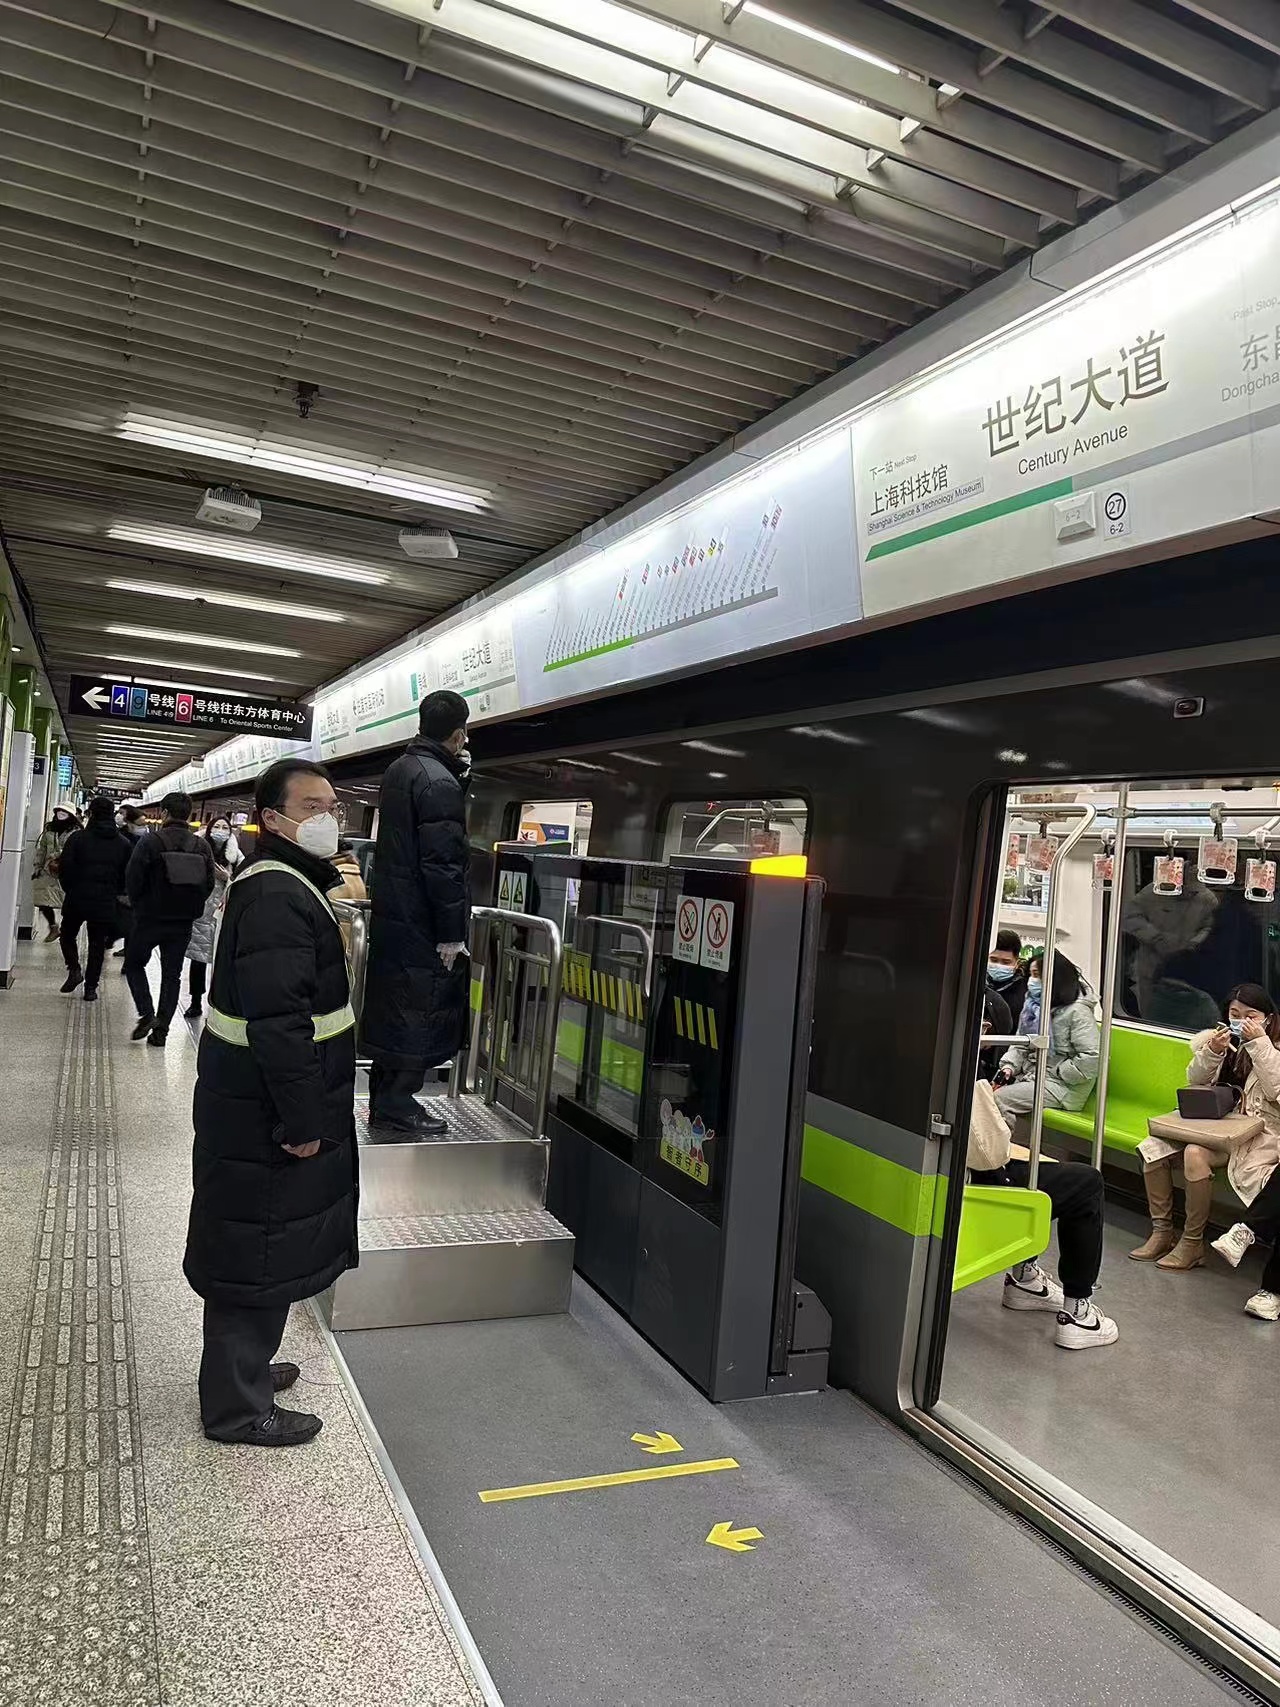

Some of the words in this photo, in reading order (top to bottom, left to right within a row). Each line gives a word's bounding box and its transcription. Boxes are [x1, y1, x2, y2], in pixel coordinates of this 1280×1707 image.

[1239, 325, 1280, 372] 东
[981, 329, 1170, 458] 世纪大道
[1018, 446, 1070, 475] Century
[1073, 424, 1128, 456] Avenue
[869, 461, 893, 481] 下一站
[870, 463, 949, 516] 上海科技馆
[868, 516, 893, 532] Shanghai
[894, 508, 915, 523] Science
[922, 492, 954, 512] Technology
[955, 480, 983, 498] Museum
[1108, 498, 1122, 515] 27
[1109, 522, 1124, 535] 6-2
[114, 693, 126, 708] 4
[133, 695, 144, 710] 9
[148, 693, 176, 709] 号线
[178, 700, 189, 715] 6
[194, 699, 307, 724] 号线往东方体育中心
[146, 709, 162, 717] LINE
[193, 714, 208, 722] LINE
[220, 717, 228, 725] To
[228, 718, 253, 728] Oriental
[253, 721, 273, 731] Sports
[273, 724, 294, 732] Center
